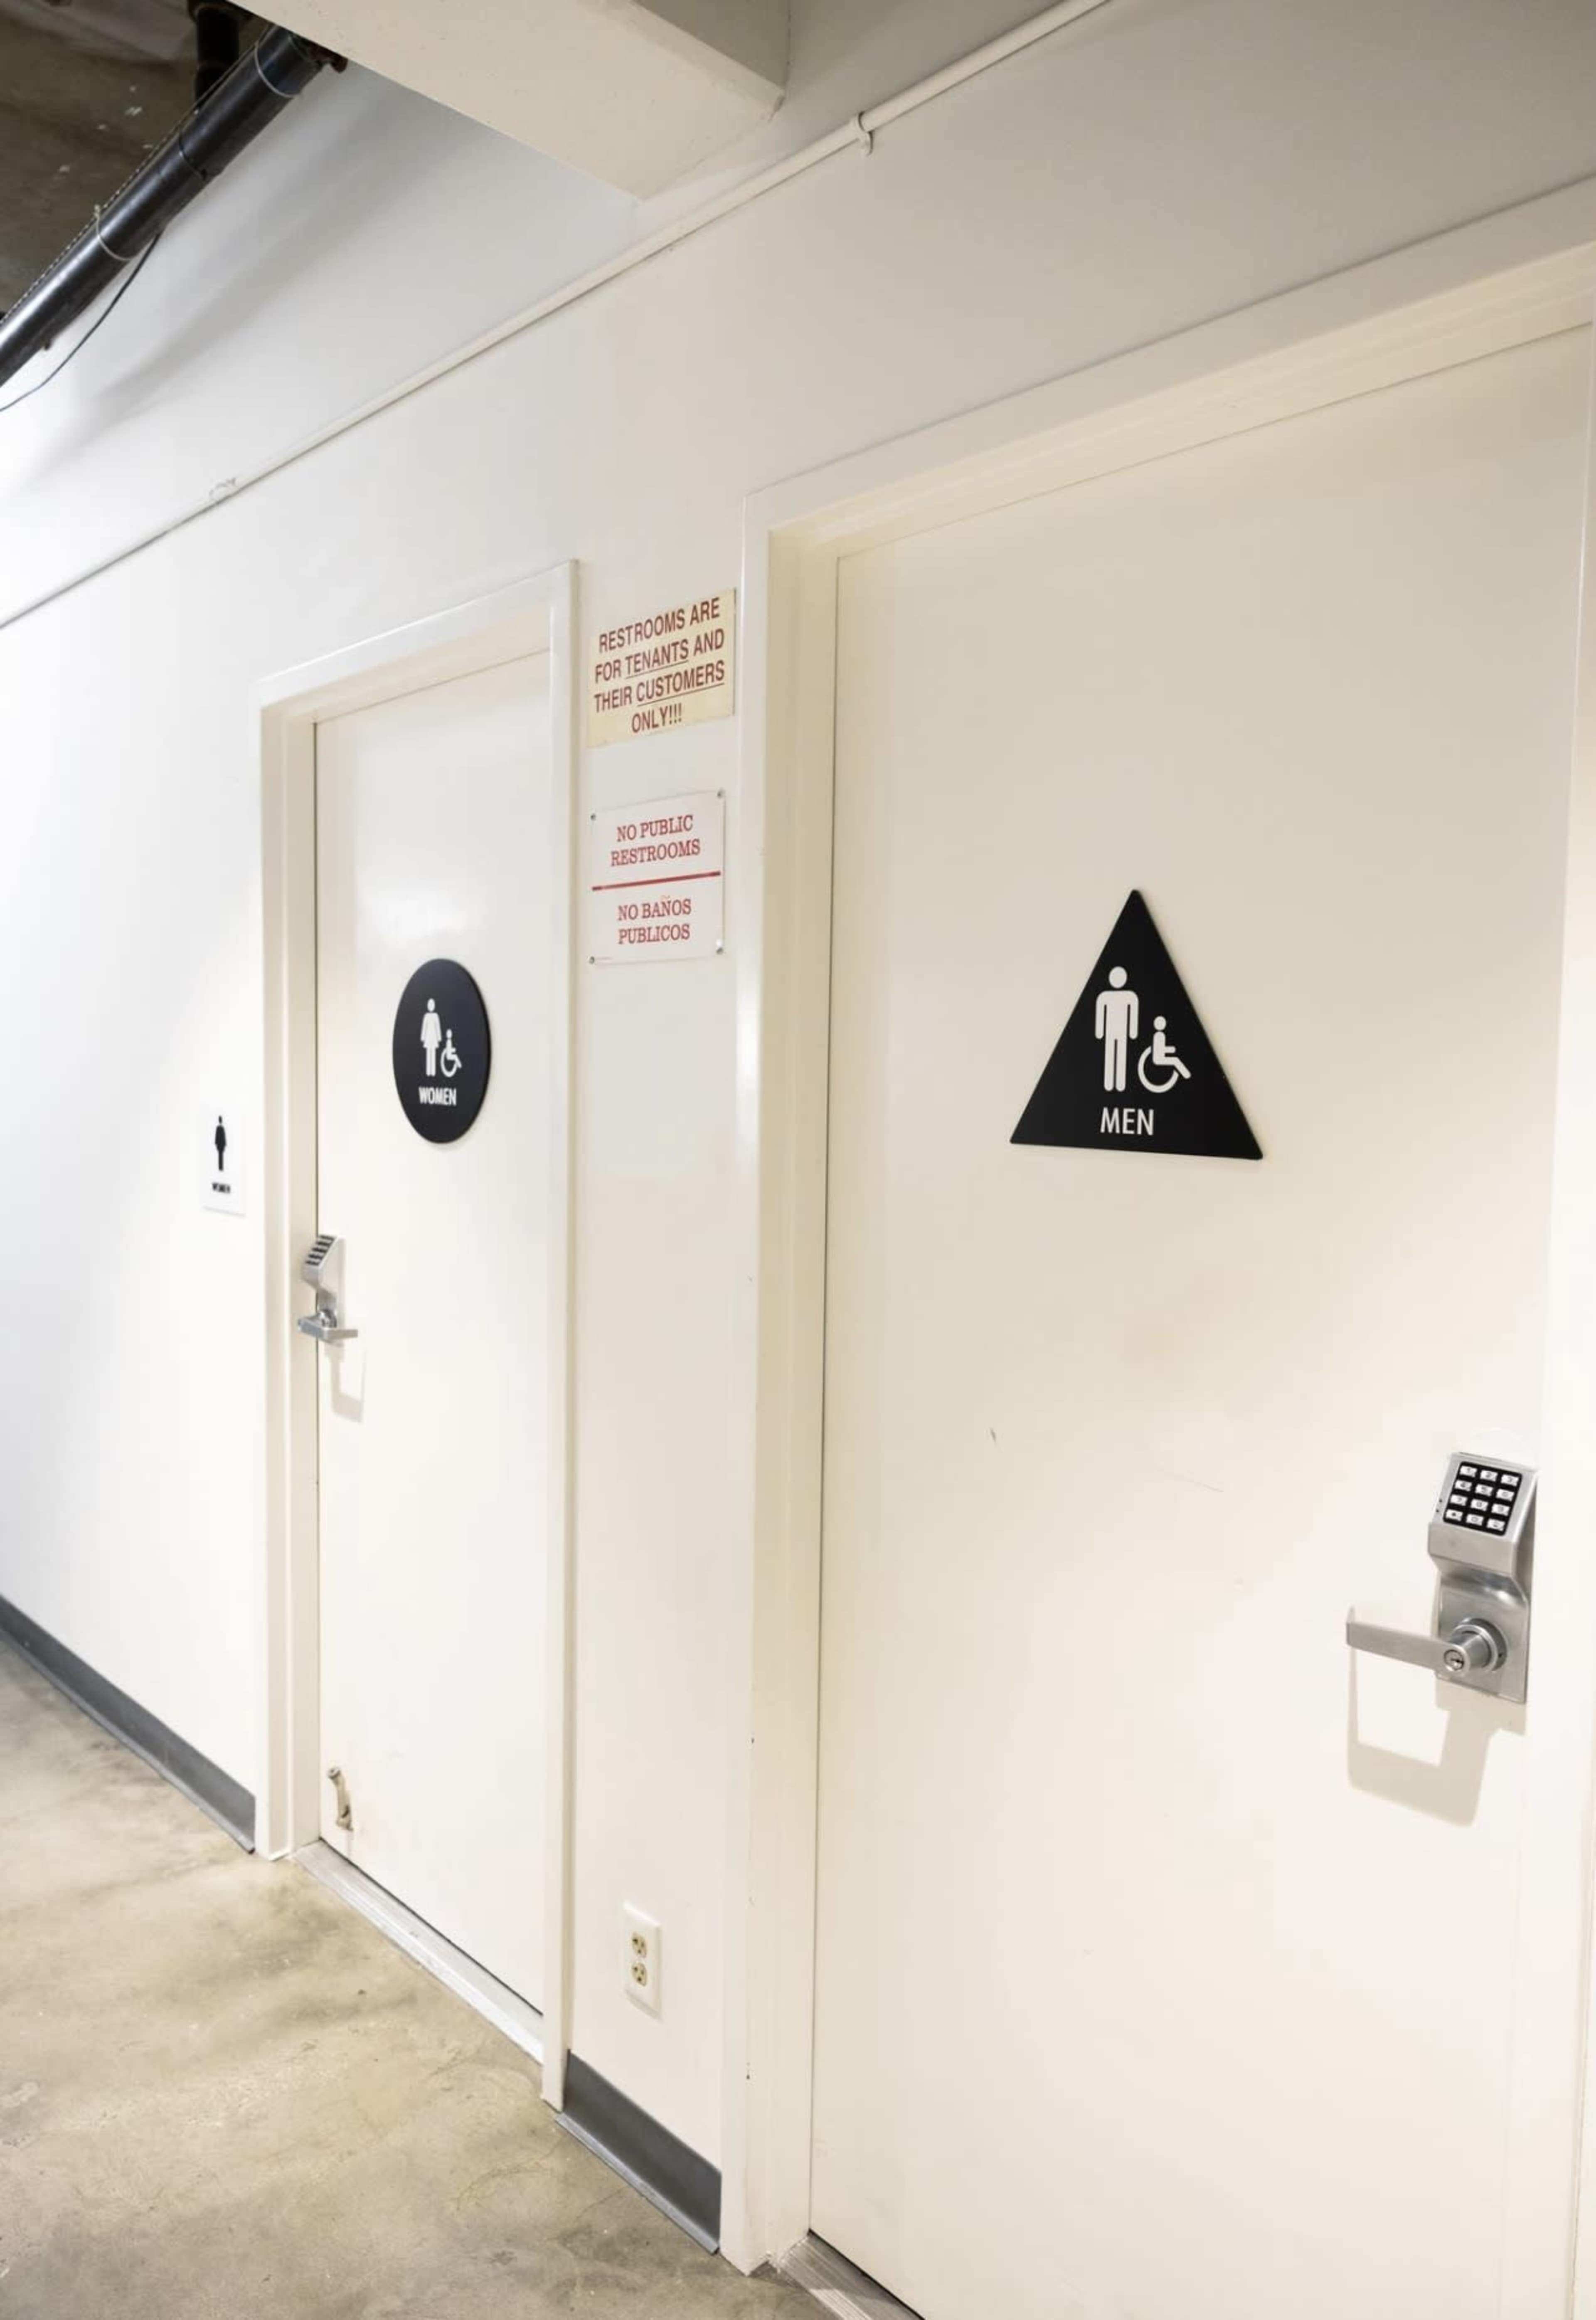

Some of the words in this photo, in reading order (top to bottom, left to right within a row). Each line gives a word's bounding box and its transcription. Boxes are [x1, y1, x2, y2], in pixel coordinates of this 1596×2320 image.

[599, 608, 685, 653] RESTROOMS
[690, 597, 720, 626] ARE
[595, 659, 621, 684] FOR
[625, 639, 689, 675] TENANTS
[693, 628, 724, 656] AND
[594, 685, 632, 713] THEIR
[636, 660, 724, 702] CUSTOMERS
[631, 703, 682, 733] ONLY!!!
[616, 824, 637, 842] NO
[640, 814, 694, 838] PUBLIC
[610, 838, 701, 867] RESTROOMS
[617, 904, 638, 921] NO
[618, 924, 690, 944] PUBLICOS
[418, 1086, 457, 1106] WOMEN
[1100, 1107, 1154, 1136] MEN
